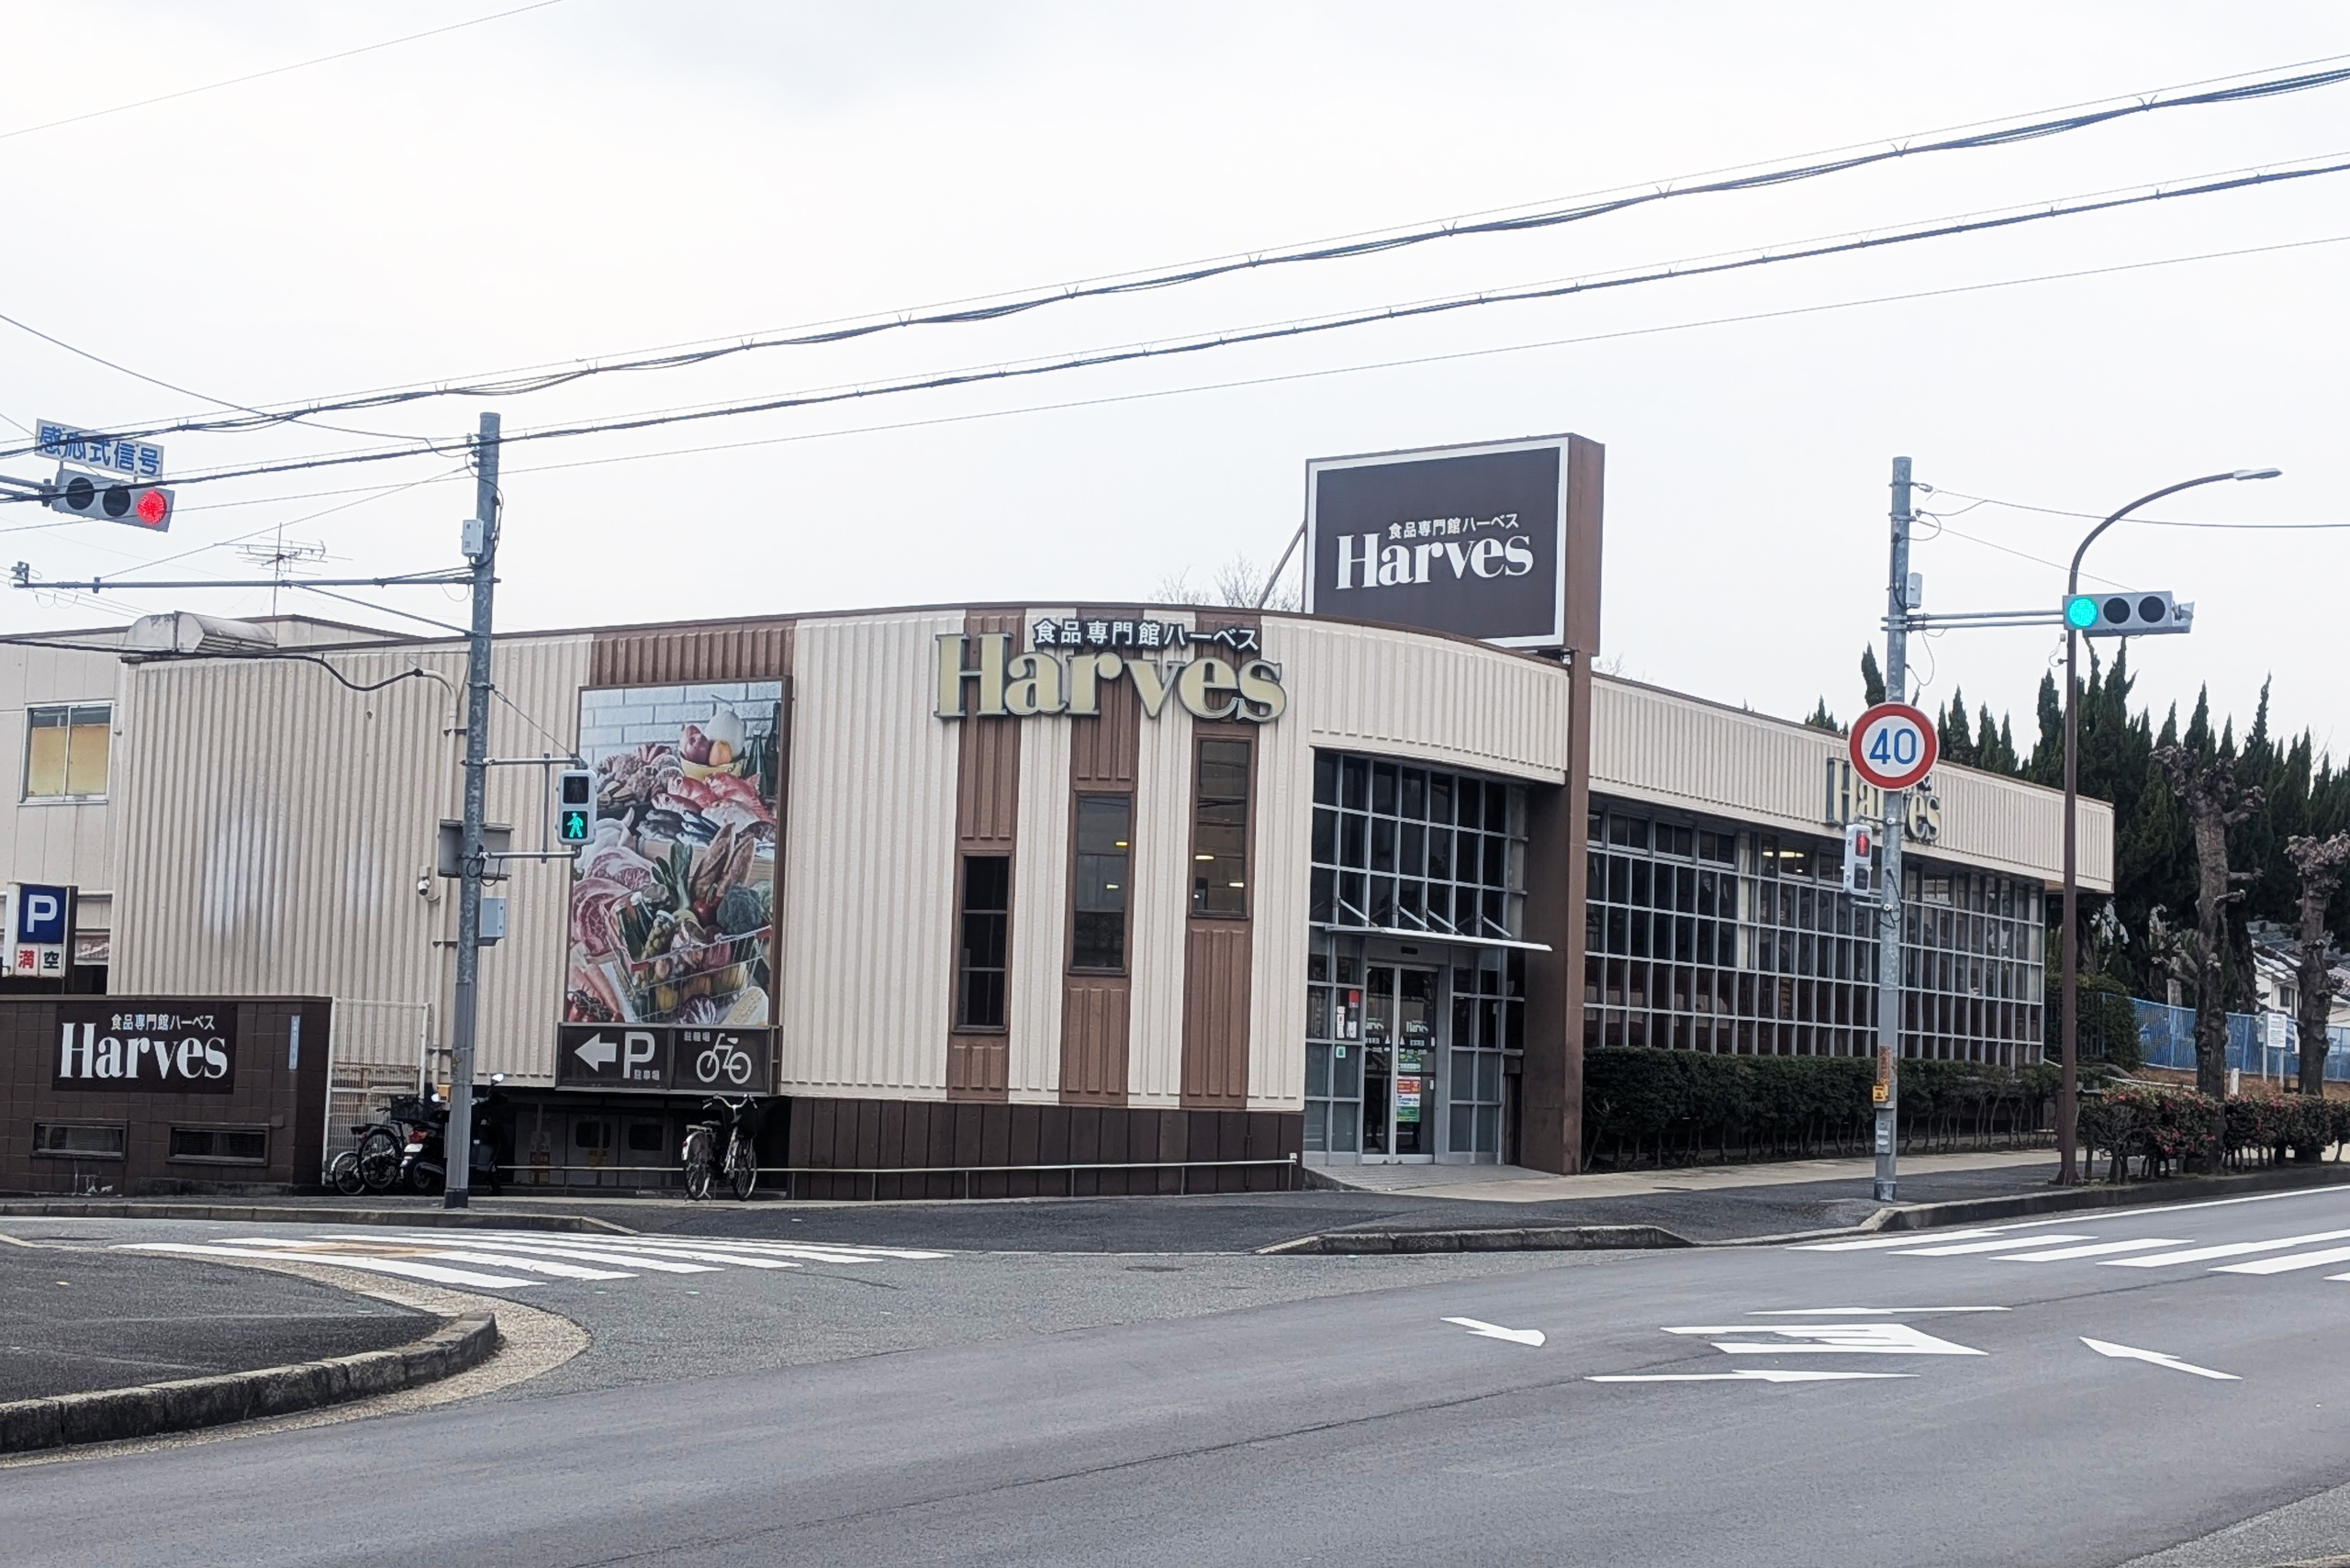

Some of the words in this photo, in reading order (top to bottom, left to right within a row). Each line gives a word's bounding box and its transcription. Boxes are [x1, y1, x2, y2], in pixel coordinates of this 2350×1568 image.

[40, 426, 160, 476] 感応式信号
[1388, 513, 1519, 540] 食品専門館ハーベス
[1336, 532, 1534, 589] Harves
[1033, 619, 1260, 652] 食品専門館ハーベス
[934, 632, 1287, 722] Harves
[1869, 728, 1917, 765] 40
[27, 894, 58, 933] P
[18, 950, 35, 969] 満
[43, 951, 60, 969] 空
[111, 1014, 216, 1031] 食品専門館ハーベス
[59, 1023, 228, 1079] Harves
[622, 1031, 655, 1079] P
